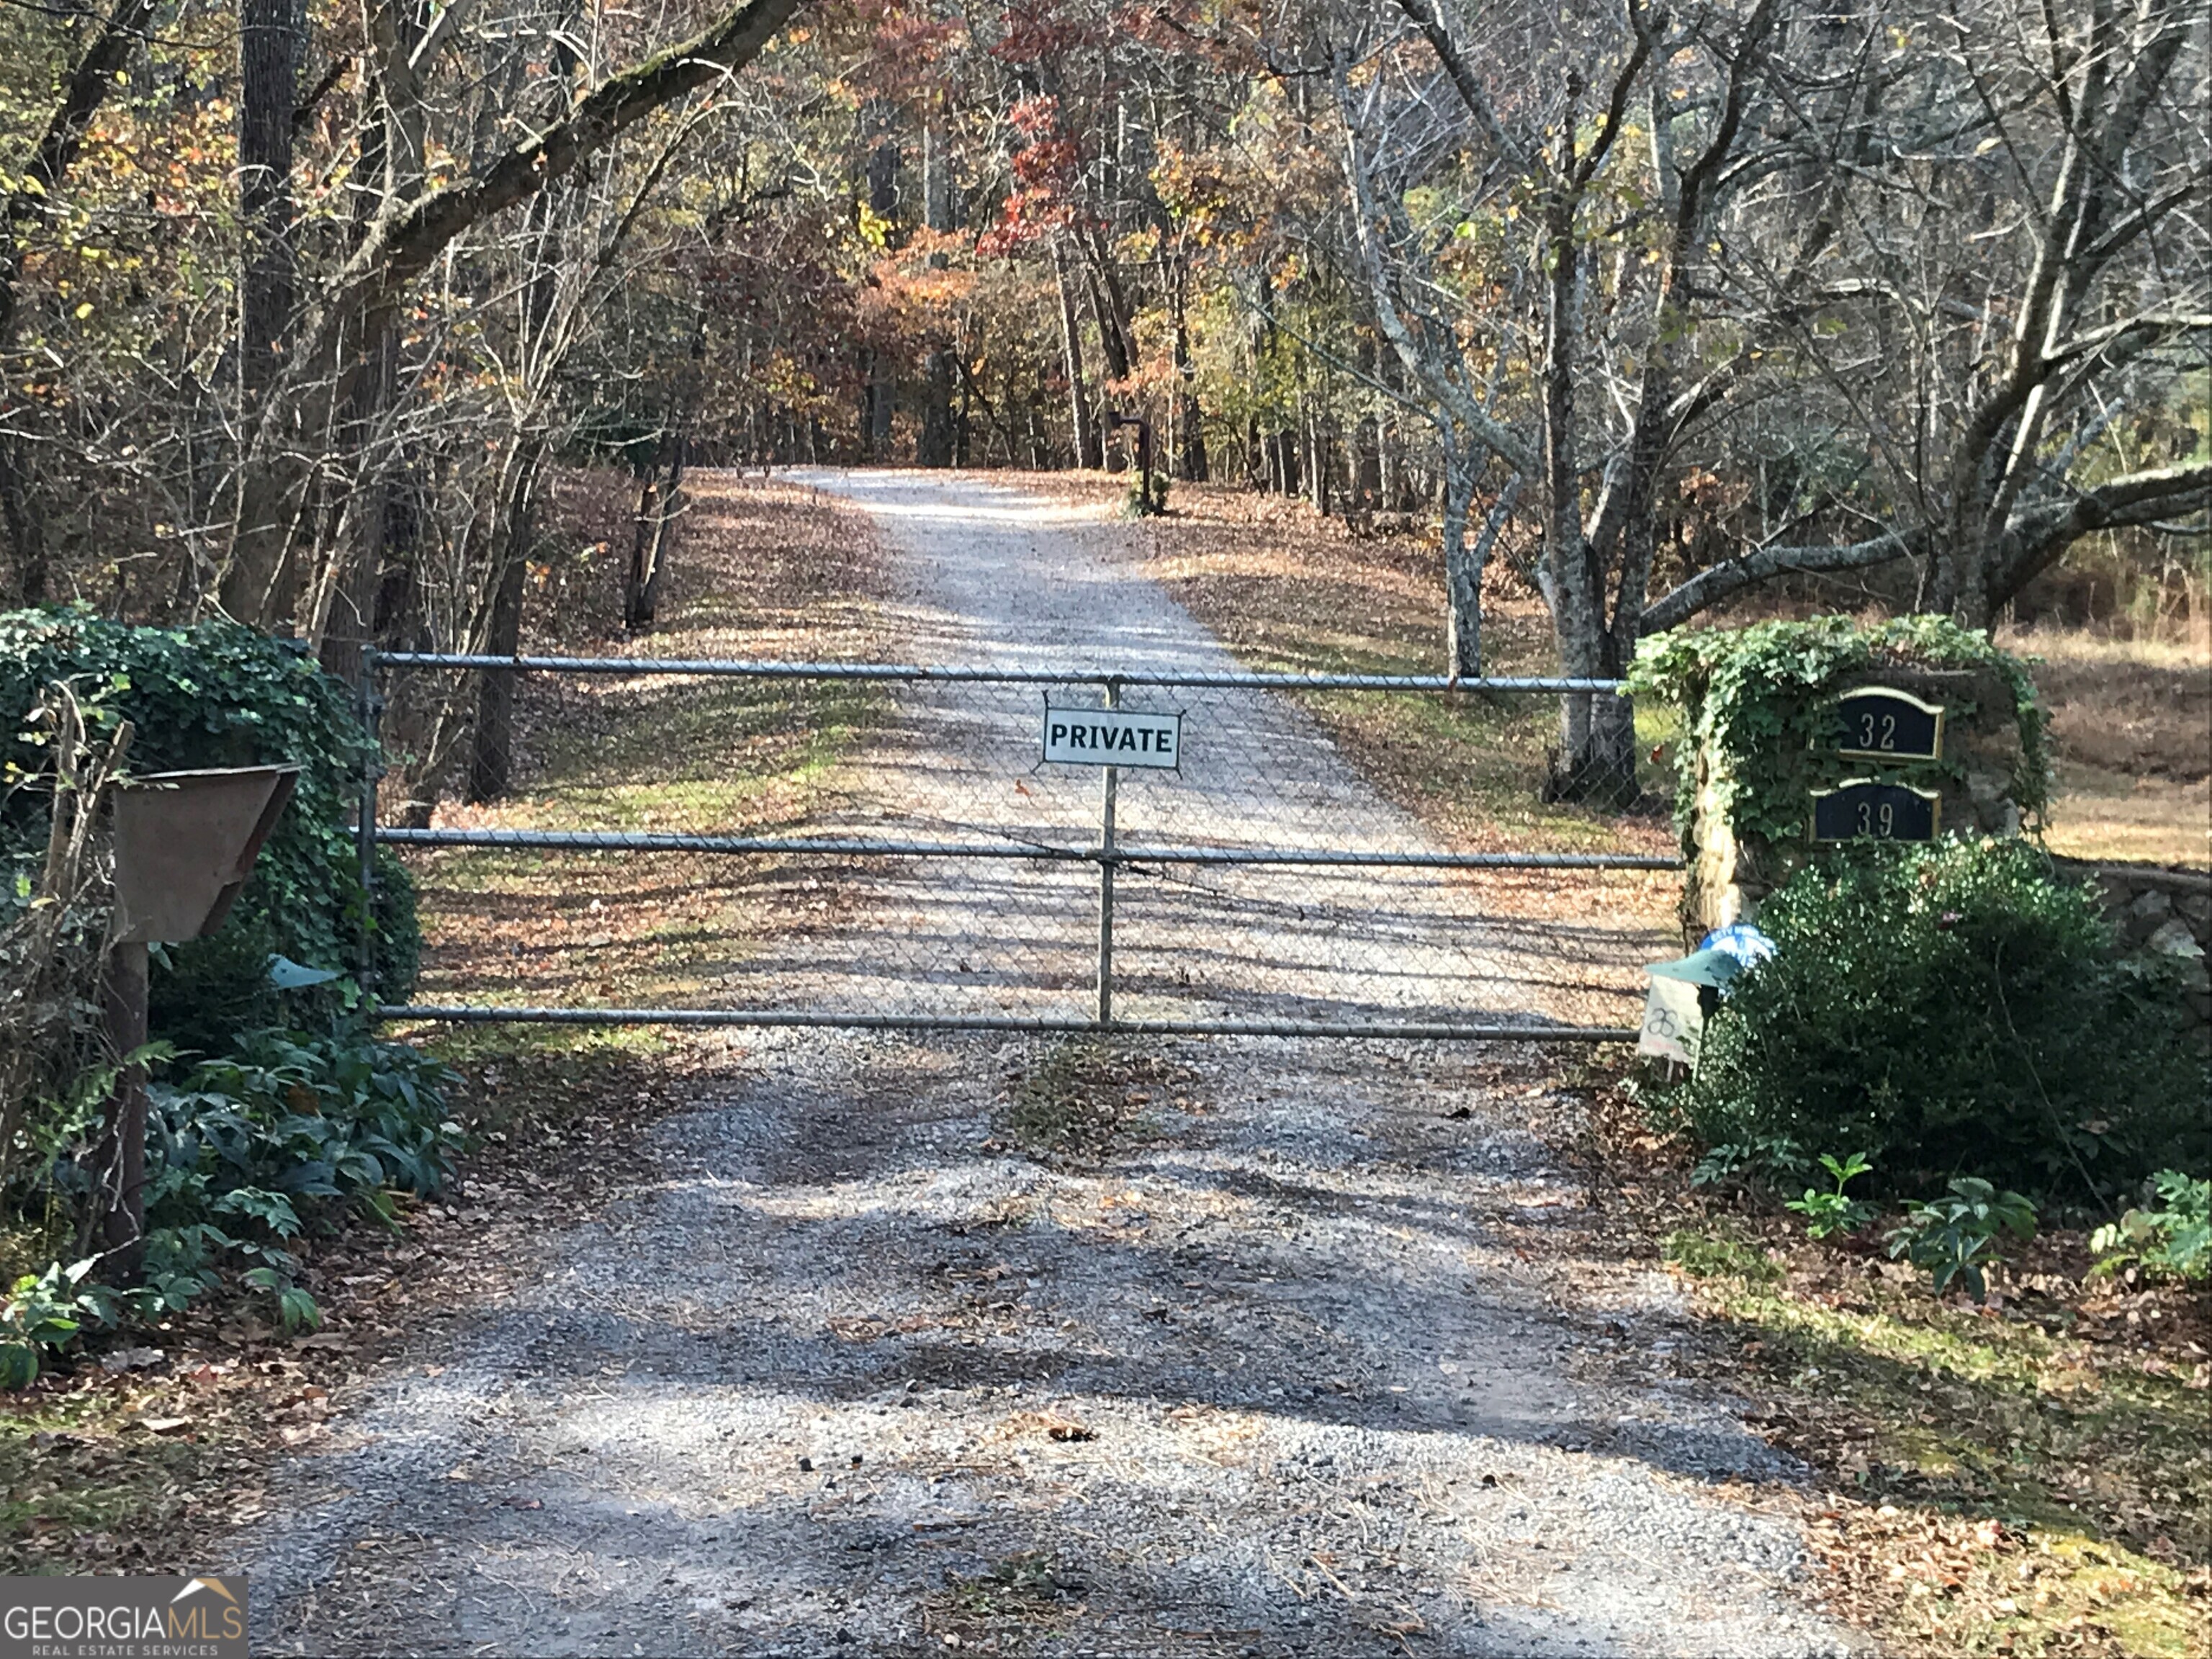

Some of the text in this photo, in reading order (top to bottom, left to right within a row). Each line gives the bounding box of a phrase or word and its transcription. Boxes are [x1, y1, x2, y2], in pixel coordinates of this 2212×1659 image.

[1051, 723, 1173, 753] PRIVATE
[1858, 712, 1896, 750] 32
[1857, 801, 1893, 837] 39
